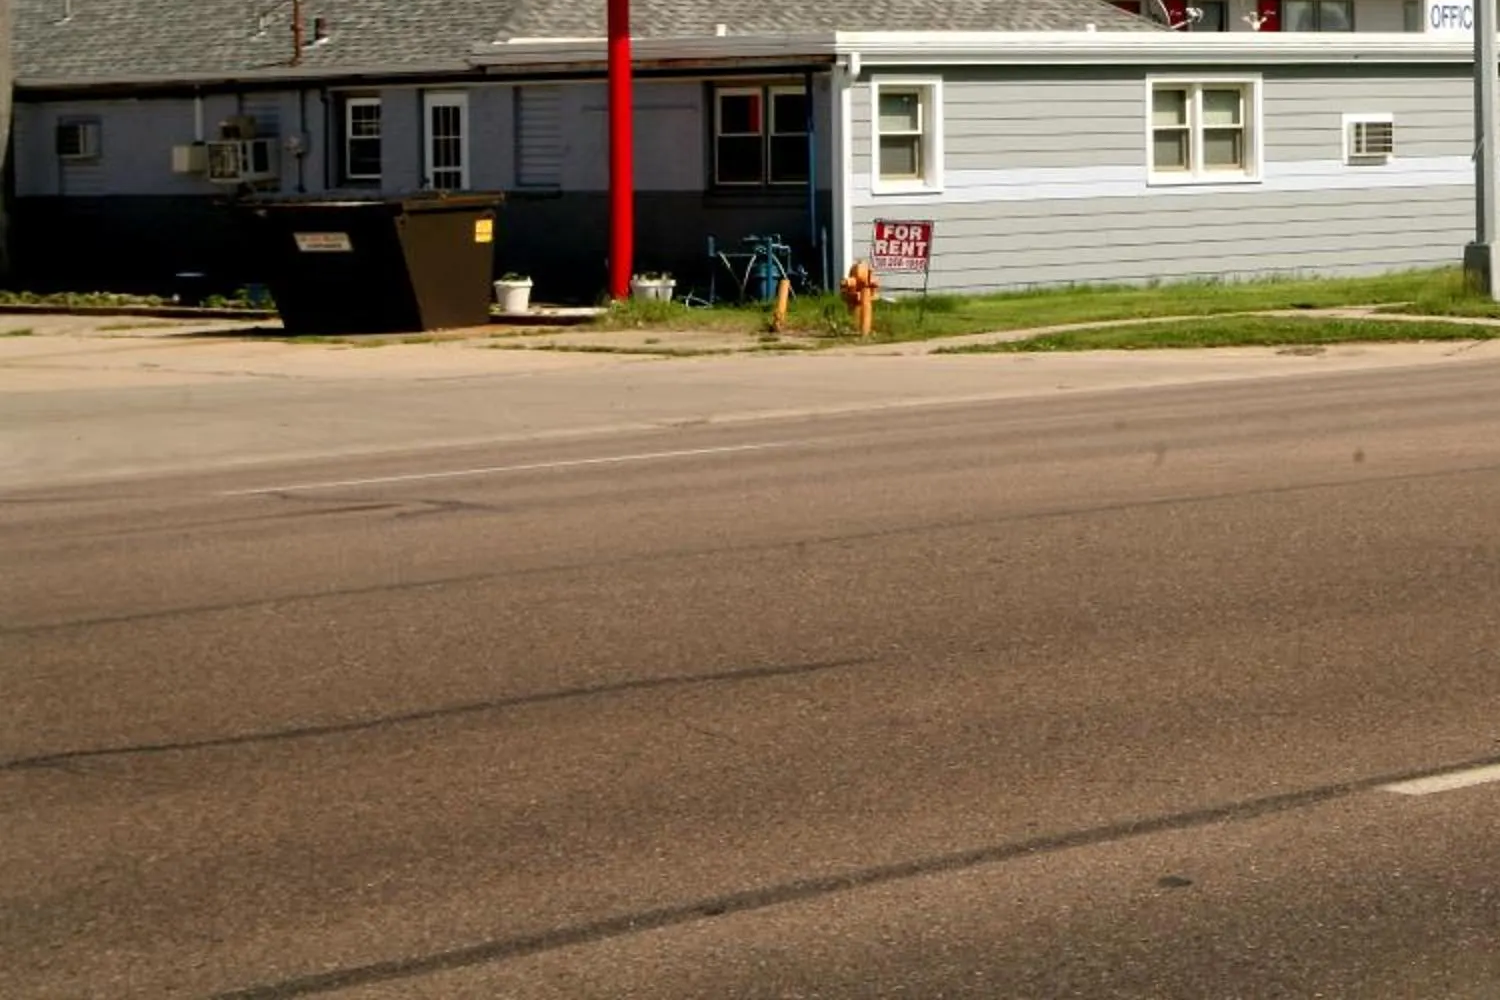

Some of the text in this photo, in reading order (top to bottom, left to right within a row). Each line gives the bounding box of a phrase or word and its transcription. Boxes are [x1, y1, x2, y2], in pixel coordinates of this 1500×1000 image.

[1431, 4, 1474, 29] OFFIC
[883, 225, 923, 240] FOR
[876, 241, 927, 256] RENT
